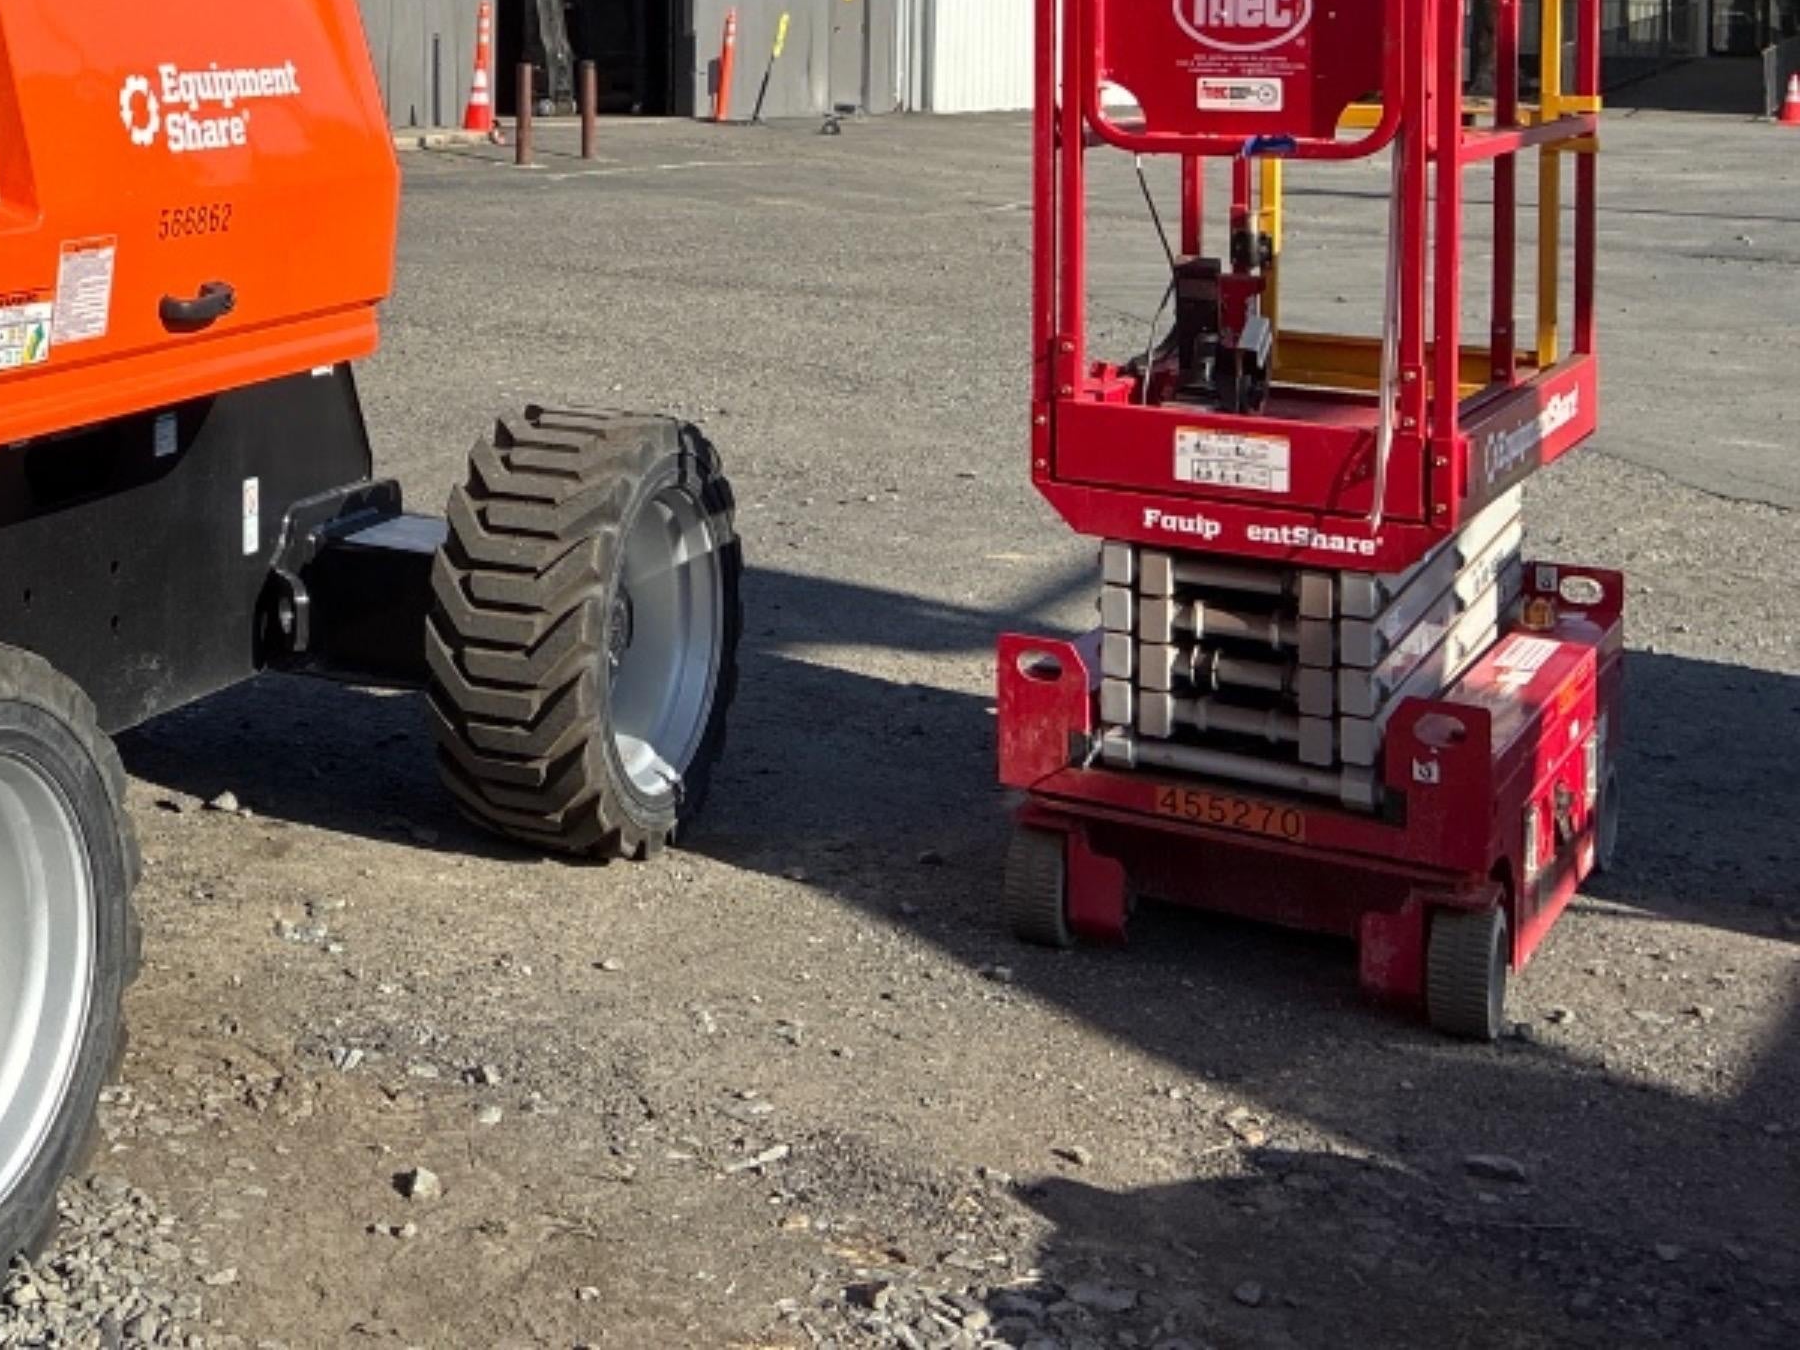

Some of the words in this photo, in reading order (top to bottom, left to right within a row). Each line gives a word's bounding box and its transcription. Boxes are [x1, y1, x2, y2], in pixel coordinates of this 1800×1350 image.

[158, 59, 301, 111] Equipment
[166, 111, 247, 153] Share
[158, 203, 233, 241] 566862
[1159, 787, 1300, 838] 455270
